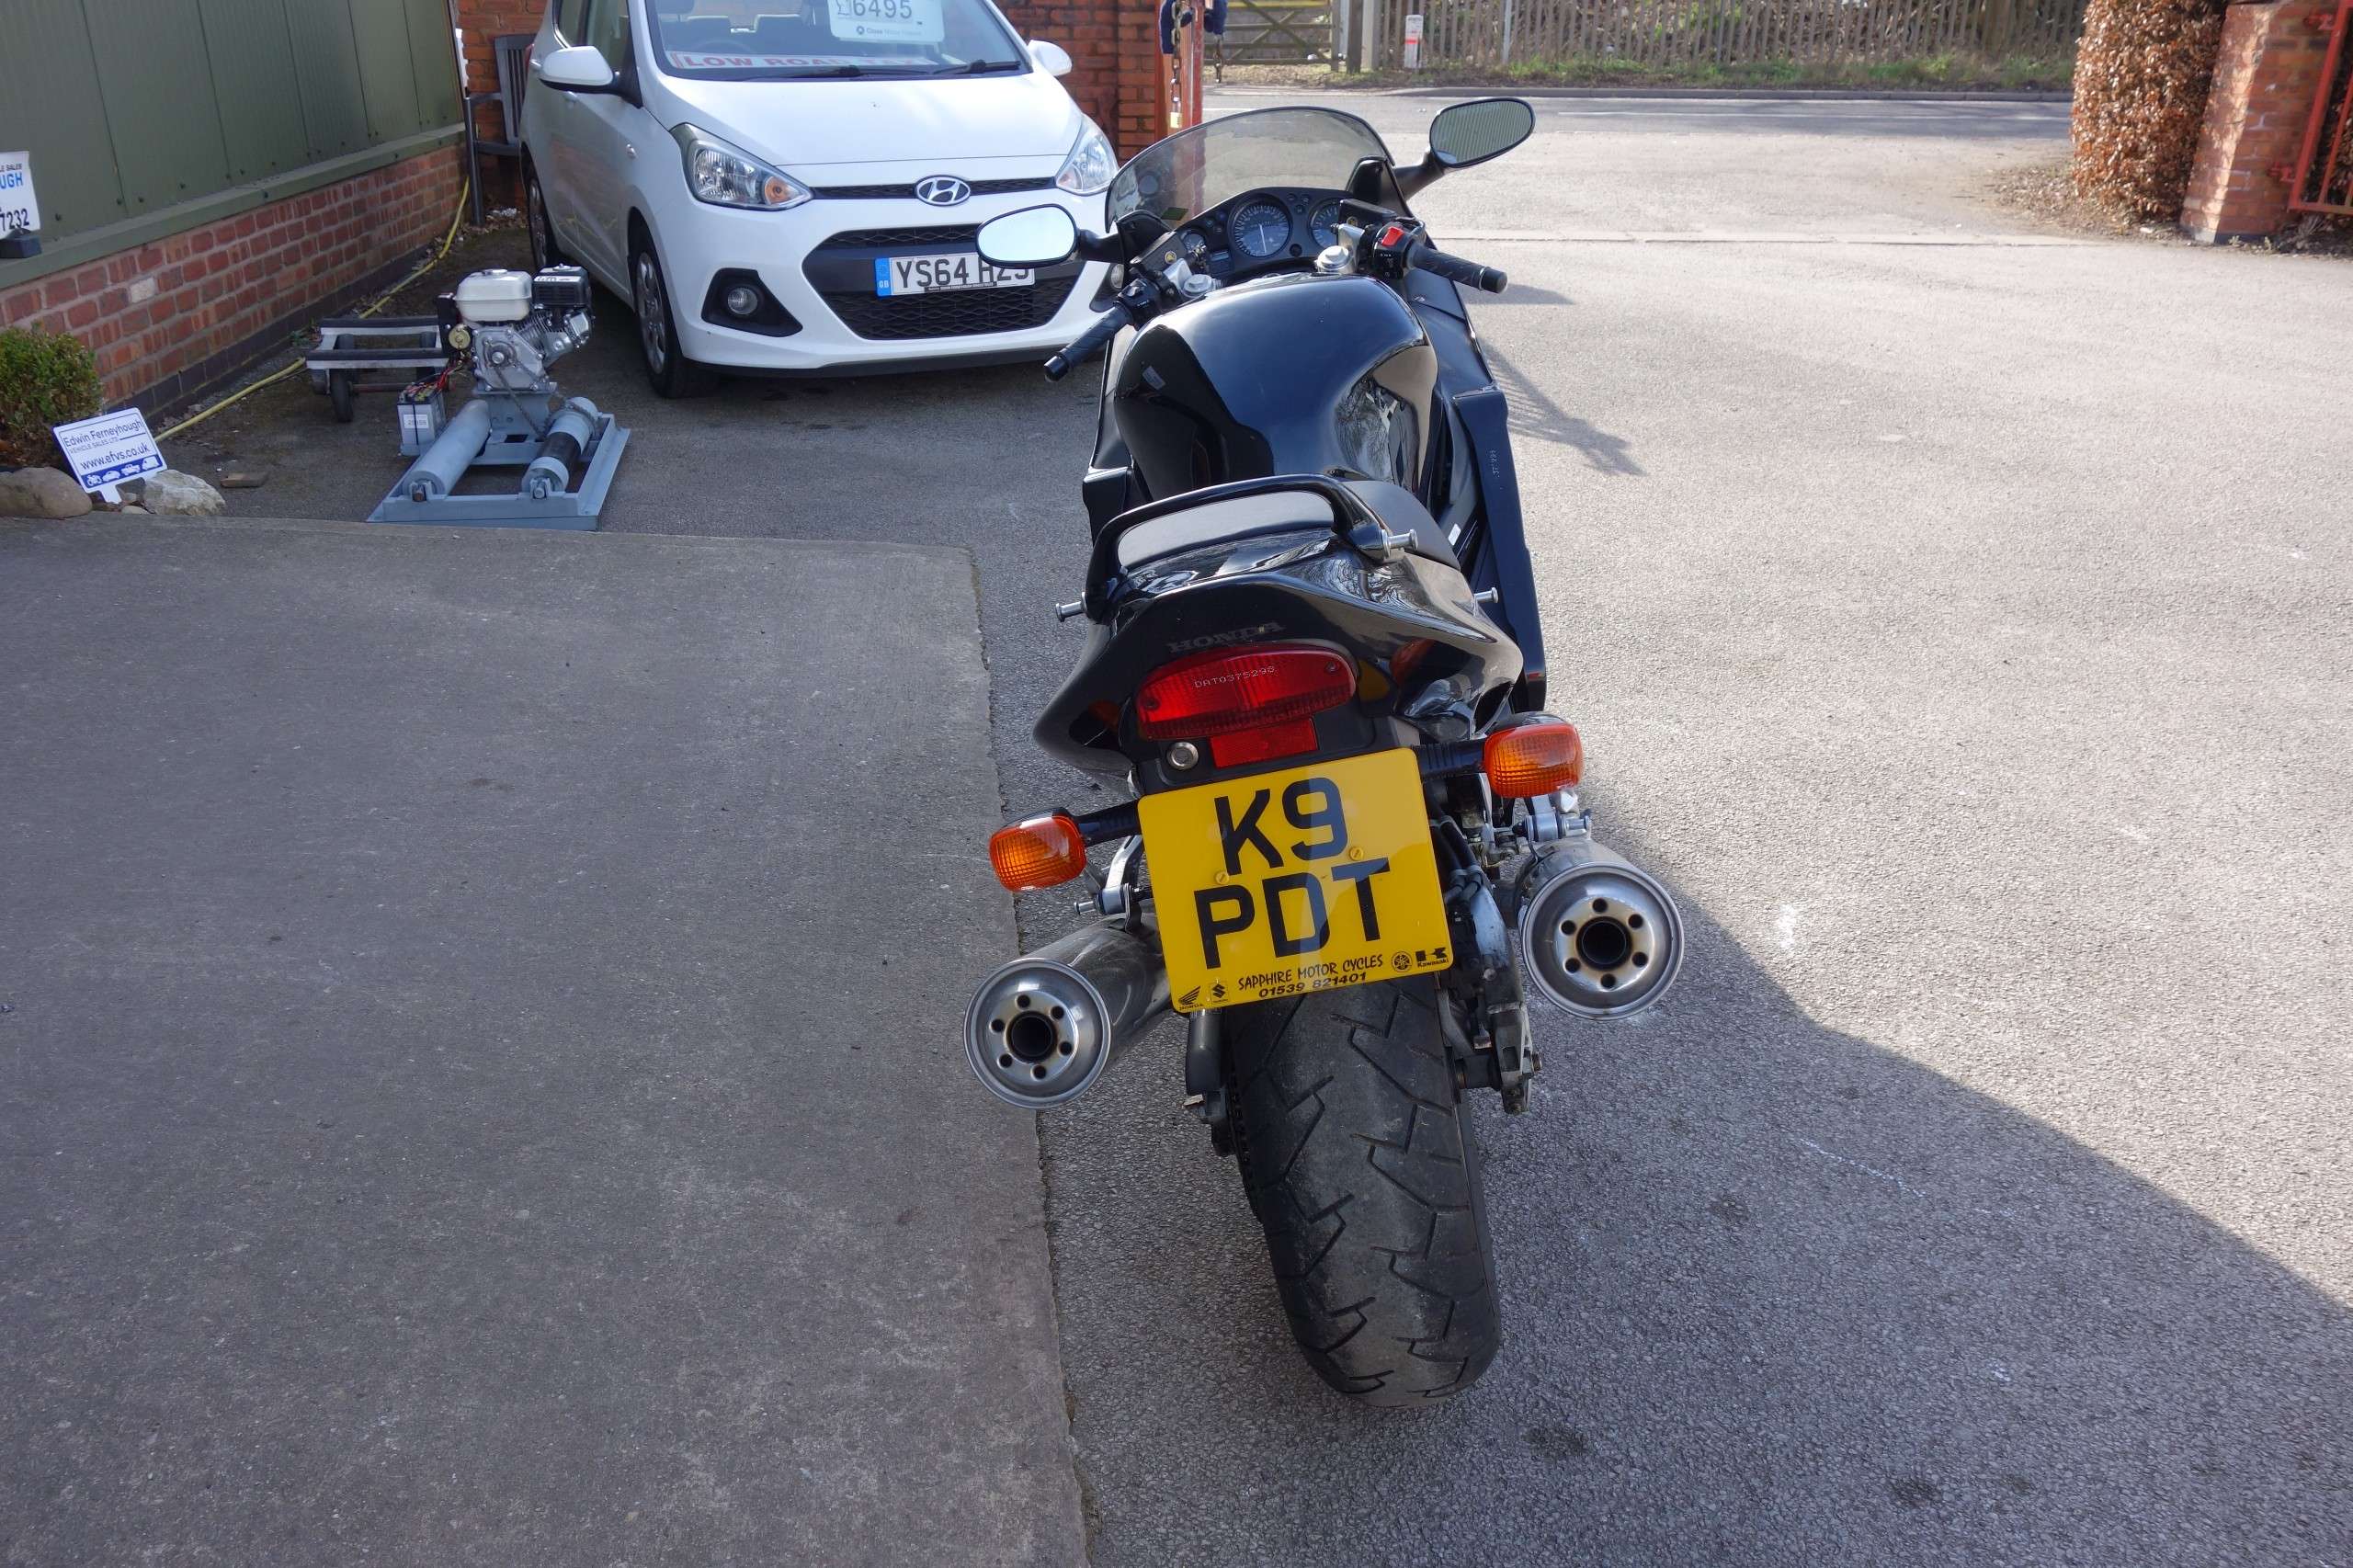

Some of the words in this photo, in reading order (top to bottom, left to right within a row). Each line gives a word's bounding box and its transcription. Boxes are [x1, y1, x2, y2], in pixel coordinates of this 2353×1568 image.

[685, 56, 752, 68] LOW
[766, 58, 847, 66] ROAD
[879, 280, 889, 289] GB
[896, 257, 969, 289] YS64
[63, 433, 90, 448] Edwin
[90, 420, 144, 439] Ferneyhough
[93, 439, 108, 448] SALES
[80, 443, 150, 470] www.efvs.co.uk
[1167, 622, 1285, 653] HONDA
[1214, 777, 1347, 876] K9
[1194, 858, 1391, 970] PDT
[1238, 969, 1292, 991] SAPPHIRE
[1297, 962, 1338, 980] MOTOR
[1342, 954, 1383, 972] CYCLES
[1417, 959, 1449, 968] Kawasaki
[1258, 983, 1305, 998] 01539
[1313, 971, 1367, 989] 821401
[1179, 1003, 1204, 1011] HONDA
